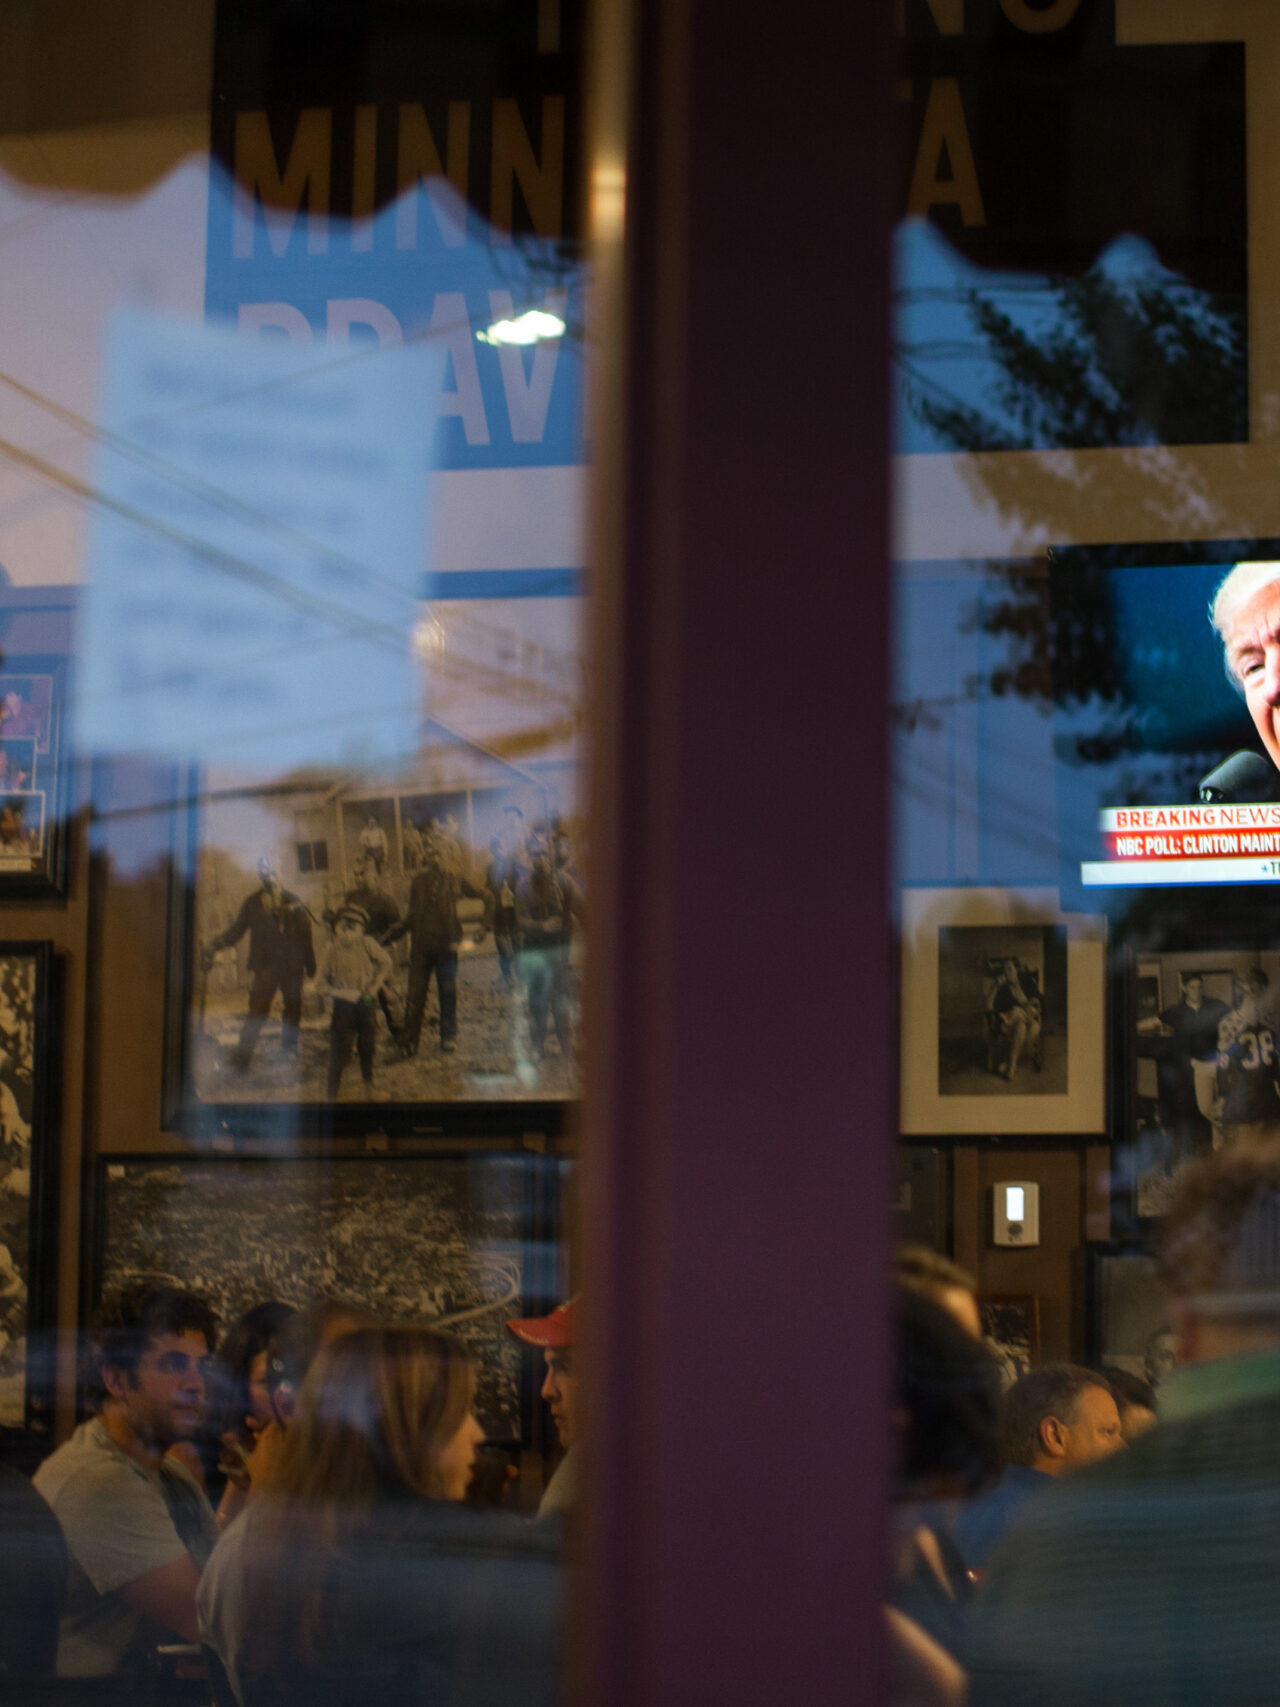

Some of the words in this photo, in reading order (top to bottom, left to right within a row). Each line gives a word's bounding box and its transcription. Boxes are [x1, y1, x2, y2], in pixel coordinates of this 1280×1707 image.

[1116, 808, 1215, 828] BREAKING
[1116, 836, 1143, 856] NBC
[1145, 834, 1182, 855] POLL:
[1183, 834, 1238, 854] CLINTON
